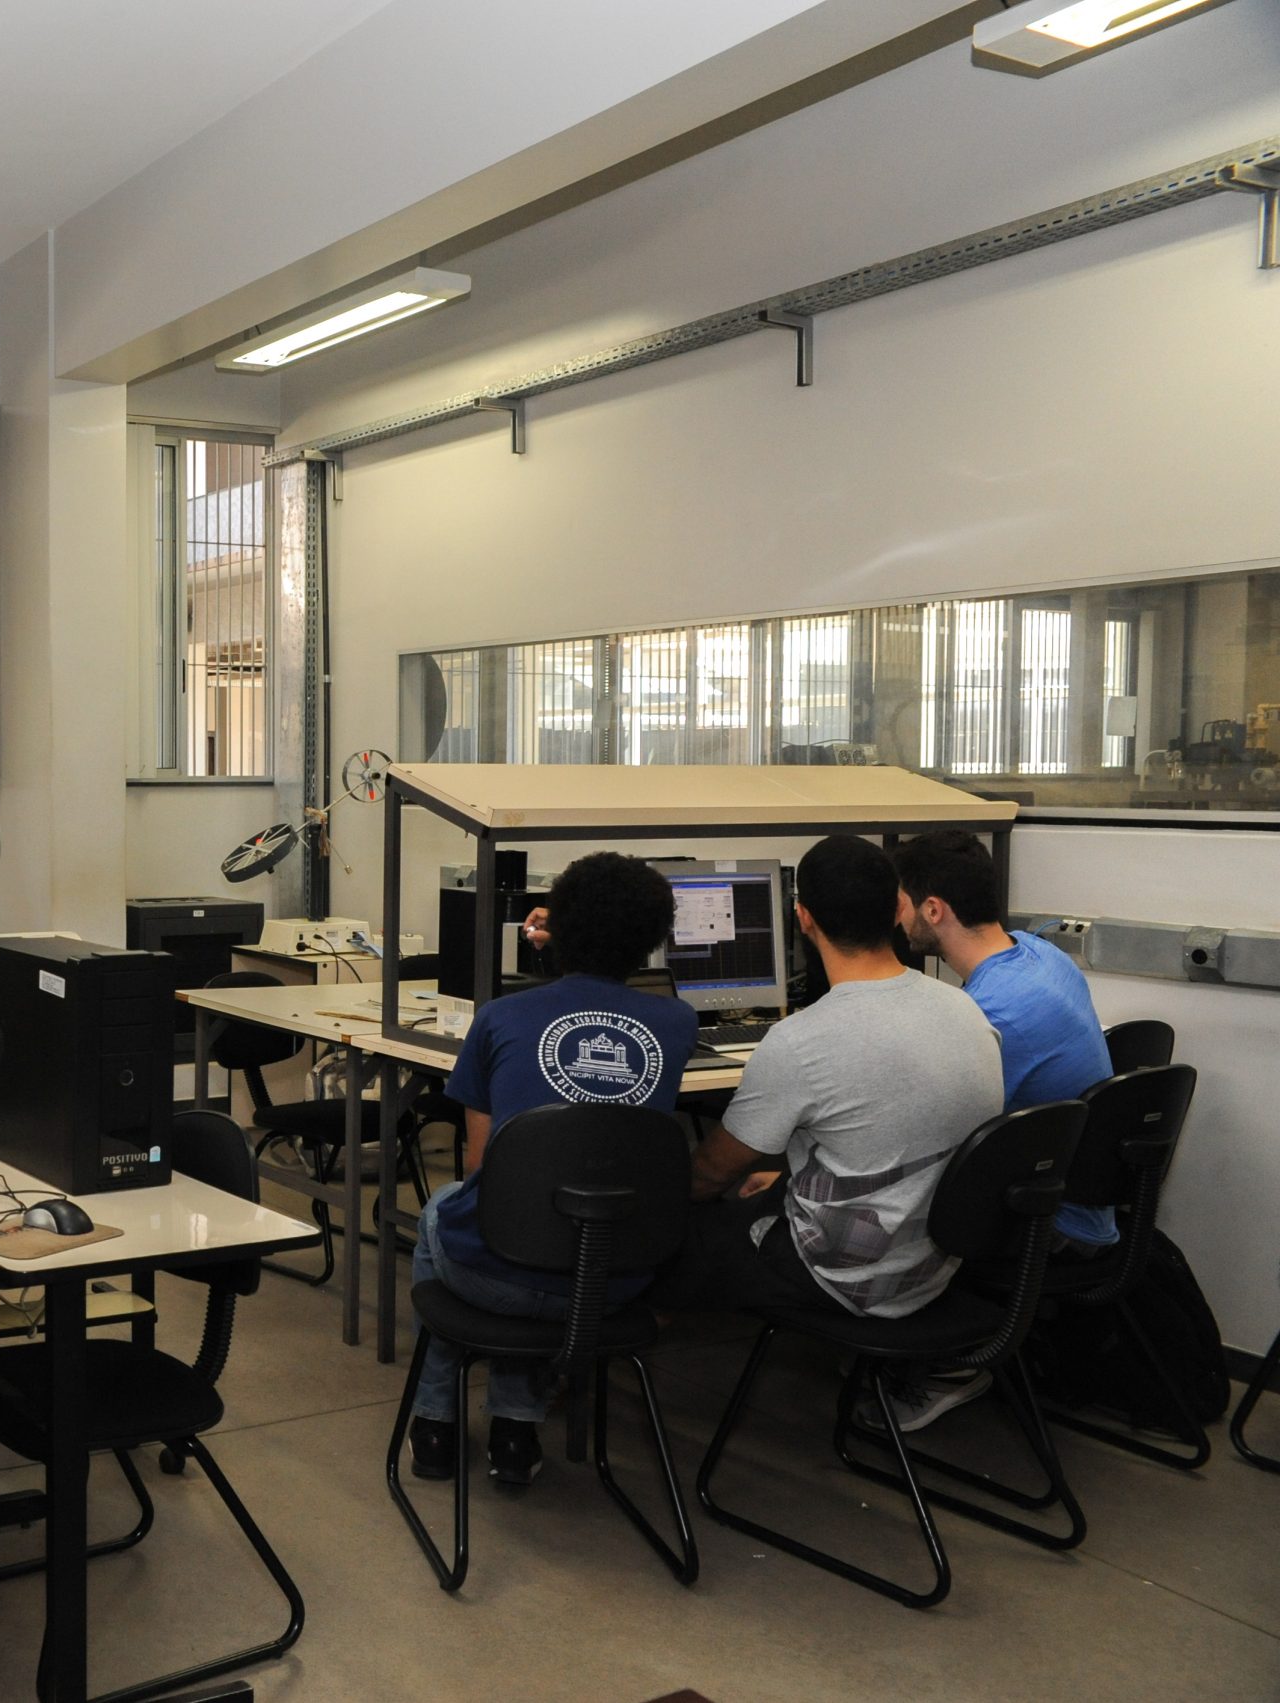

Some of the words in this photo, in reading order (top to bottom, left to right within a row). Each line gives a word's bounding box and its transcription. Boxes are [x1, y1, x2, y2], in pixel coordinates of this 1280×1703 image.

[544, 1020, 573, 1067] UNIVERSIDADE
[574, 1016, 612, 1024] FEDERAL
[617, 1020, 629, 1030] DE
[631, 1027, 654, 1049] MINAS
[648, 1052, 658, 1080] GERAIS
[569, 1071, 595, 1080] INCIPIT
[597, 1074, 614, 1082] VITA
[615, 1076, 636, 1085] NOVA
[557, 1078, 570, 1090] DE
[631, 1083, 649, 1101] 1927
[102, 1153, 148, 1165] POSITIVO
